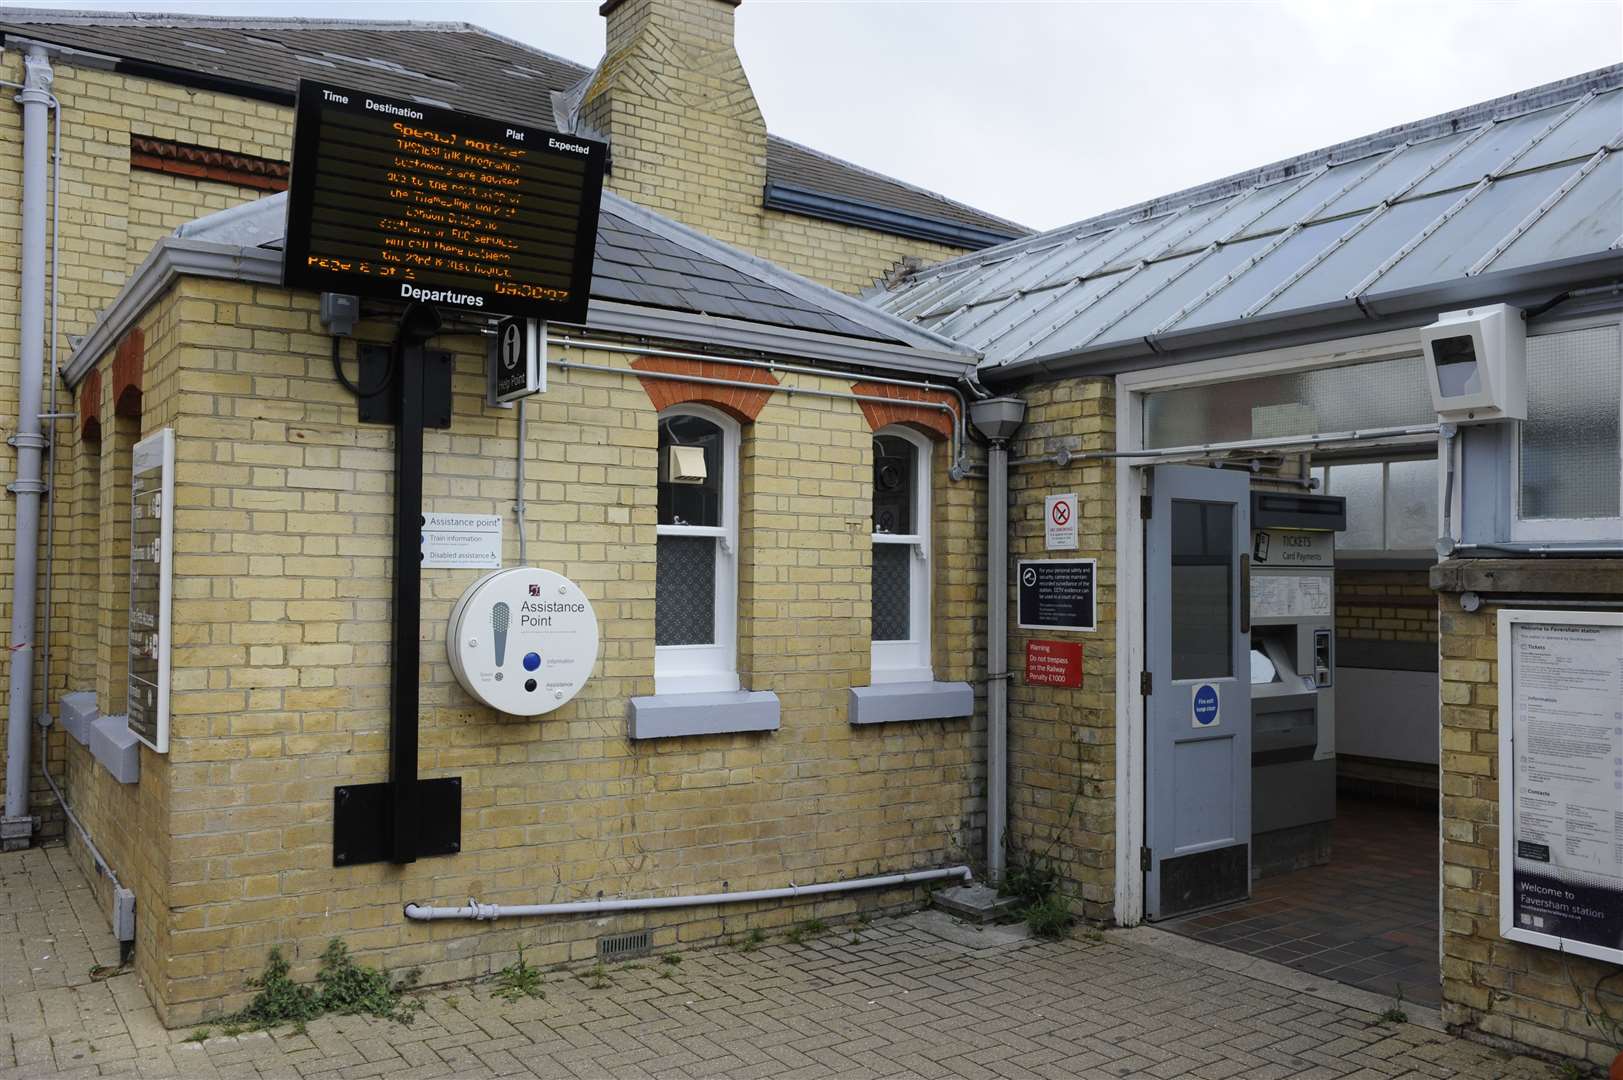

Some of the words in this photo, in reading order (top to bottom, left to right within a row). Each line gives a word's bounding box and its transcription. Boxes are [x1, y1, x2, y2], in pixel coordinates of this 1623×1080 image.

[322, 90, 349, 104] Time
[365, 99, 424, 120] Destination
[506, 128, 525, 141] Plat
[548, 138, 590, 156] Expected
[401, 283, 484, 307] Departures
[431, 518, 474, 527] Assistance
[476, 518, 497, 528] point
[1283, 536, 1312, 548] TICKETS
[1282, 552, 1296, 561] Card
[1297, 552, 1322, 563] Payments
[521, 601, 585, 613] Assistance
[521, 615, 552, 627] Point
[1030, 644, 1050, 653] Warning
[1047, 657, 1068, 665] trespass
[1047, 665, 1065, 674] Railway
[1030, 672, 1048, 682] Penalty
[1049, 674, 1065, 682] £1000
[1521, 882, 1562, 898] Welcome
[1565, 891, 1575, 900] to
[1521, 894, 1569, 912] Faversham
[1572, 906, 1605, 919] station
